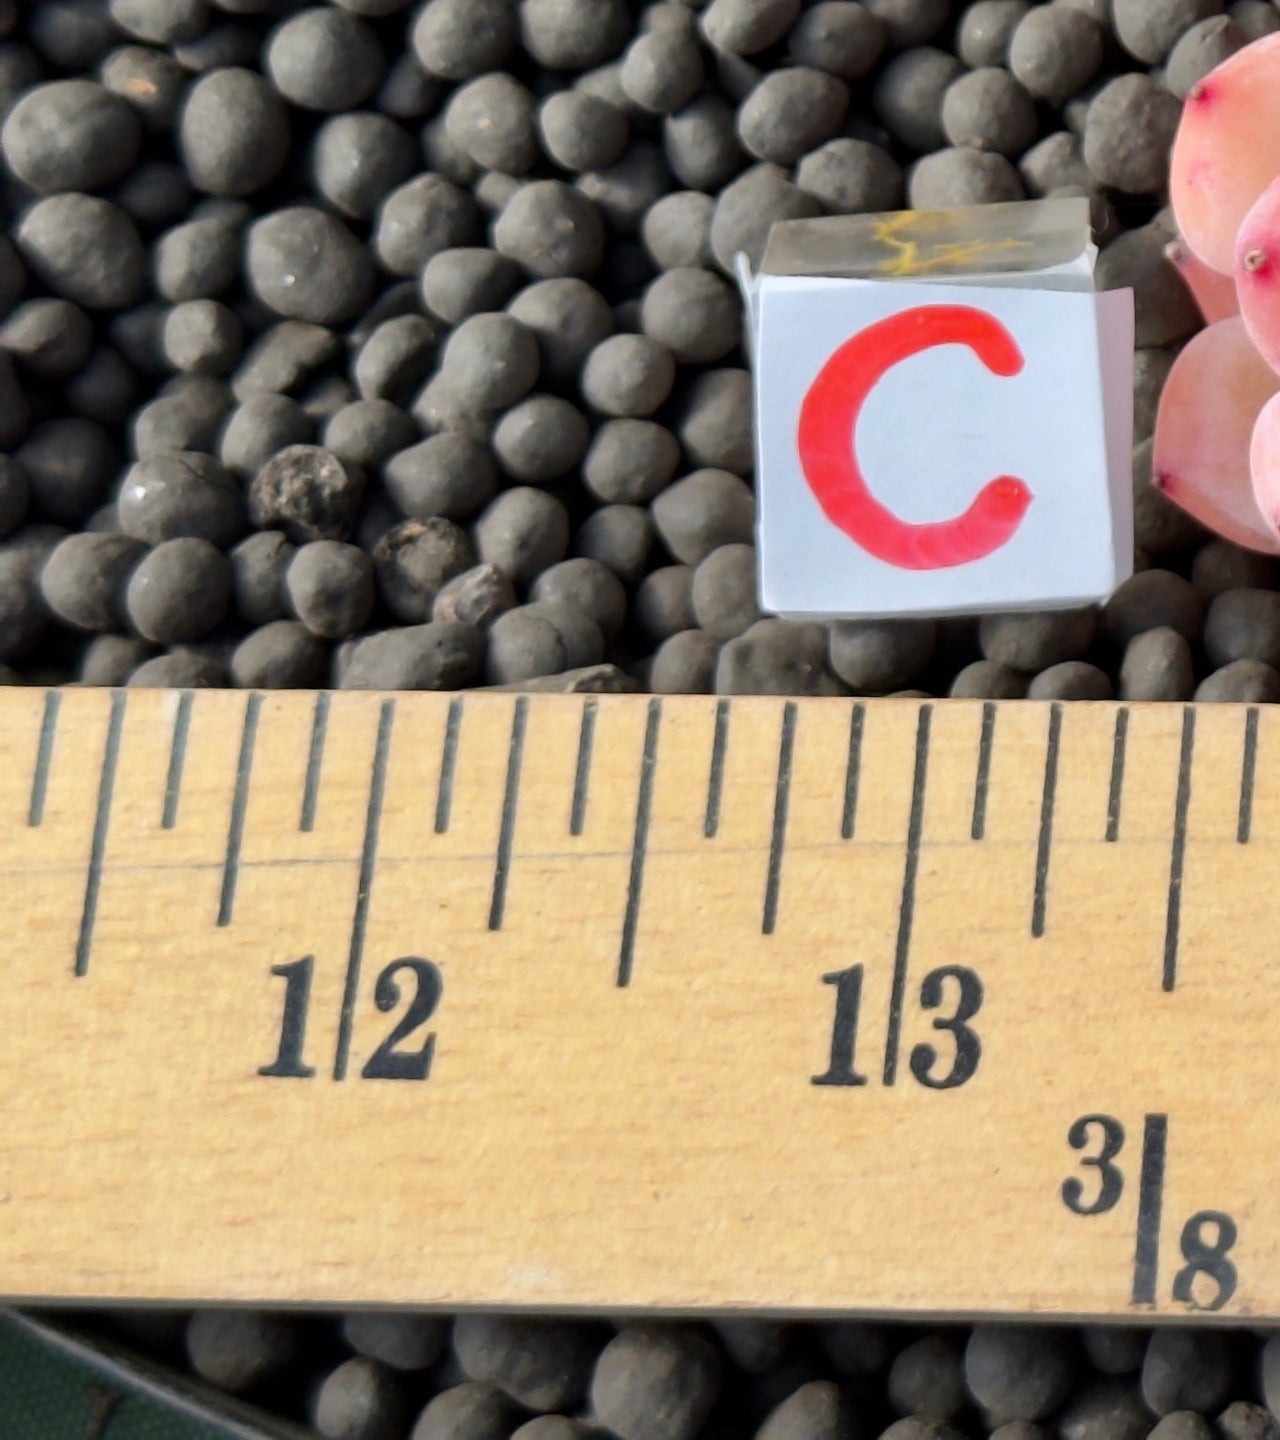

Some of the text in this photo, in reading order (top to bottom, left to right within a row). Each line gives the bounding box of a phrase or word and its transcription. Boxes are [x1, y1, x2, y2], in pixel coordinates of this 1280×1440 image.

[797, 304, 1034, 570] C
[257, 956, 443, 1082] 12
[810, 964, 984, 1090] 13
